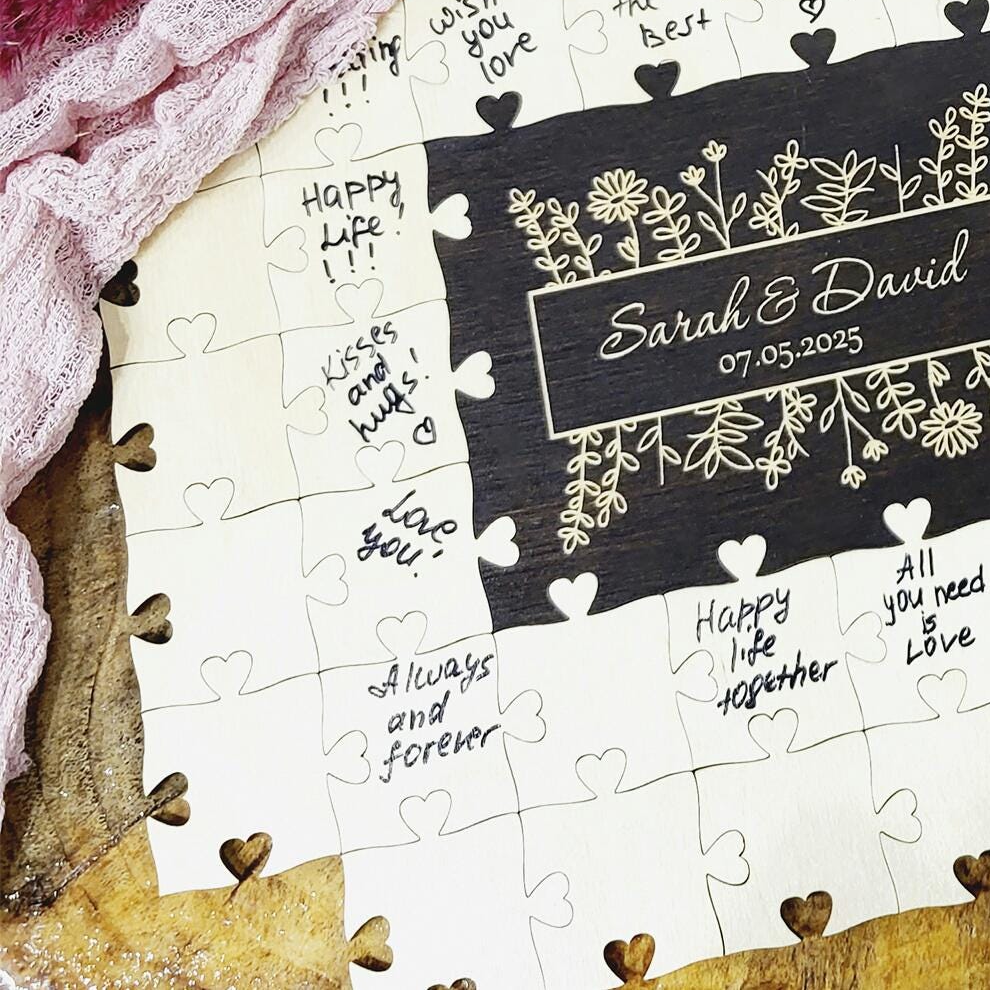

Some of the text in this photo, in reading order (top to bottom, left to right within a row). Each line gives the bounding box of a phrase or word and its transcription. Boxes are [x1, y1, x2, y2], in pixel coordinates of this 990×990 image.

[461, 11, 515, 58] you
[639, 8, 712, 48] Best
[480, 31, 538, 84] love
[300, 170, 401, 217] Happy
[599, 228, 970, 361] Sarah & David
[718, 326, 864, 378] 07.05.2025
[347, 352, 391, 407] and
[381, 488, 459, 544] Love
[896, 549, 934, 584] All
[695, 587, 791, 642] Happy
[883, 566, 986, 627] you need
[905, 625, 977, 666] Love
[921, 612, 938, 633] is
[730, 624, 779, 673] life
[367, 652, 496, 699] Always
[717, 649, 839, 716] together
[387, 689, 451, 734] and
[378, 723, 502, 784] forever
